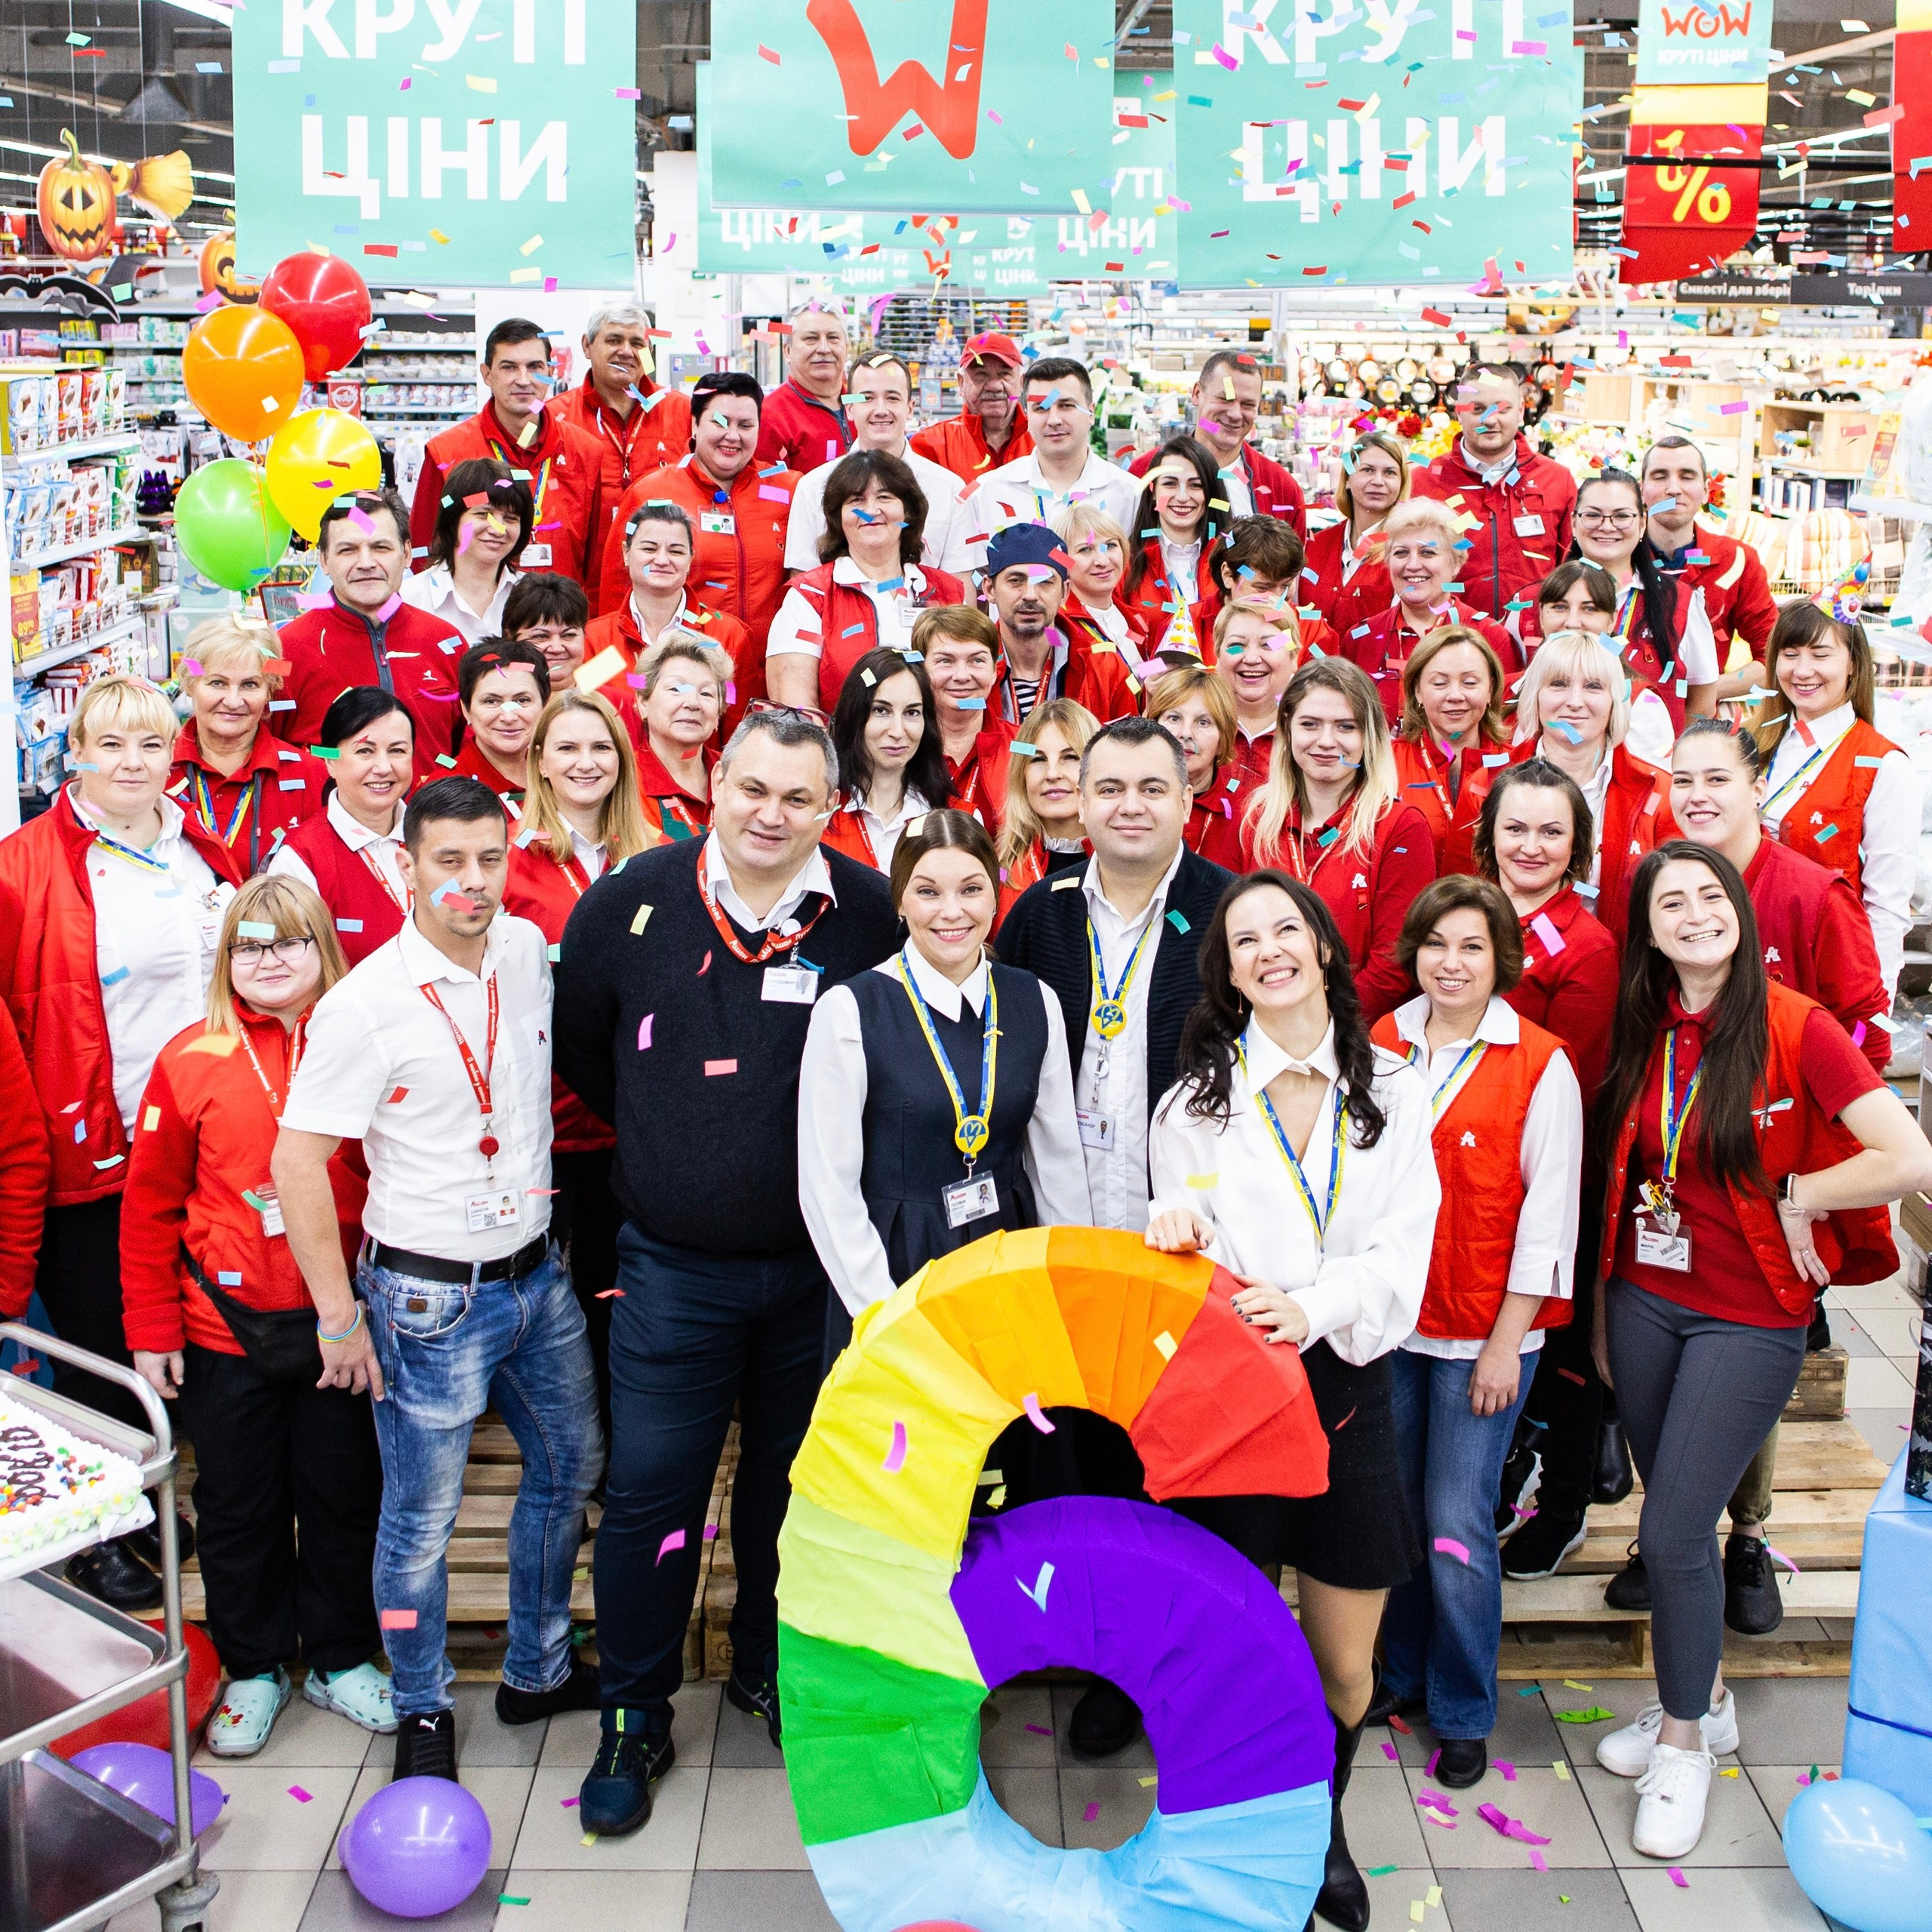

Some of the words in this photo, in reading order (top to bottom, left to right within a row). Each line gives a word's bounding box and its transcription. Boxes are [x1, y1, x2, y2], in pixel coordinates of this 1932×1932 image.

[1661, 2, 1752, 38] WOW
[1657, 48, 1703, 65] КРУТІ
[1706, 48, 1749, 67] ЦІНИ
[302, 115, 568, 220] ЦІНИ
[1242, 115, 1506, 223] ЦІНИ
[721, 212, 820, 251] ЦІНИ
[1058, 217, 1156, 257] ЦІНИ
[841, 267, 885, 286] ЦІНИ
[1728, 285, 1753, 297] для
[1847, 282, 1903, 300] Тарілки
[698, 869, 706, 892] Ашан
[729, 940, 748, 960] Ашан
